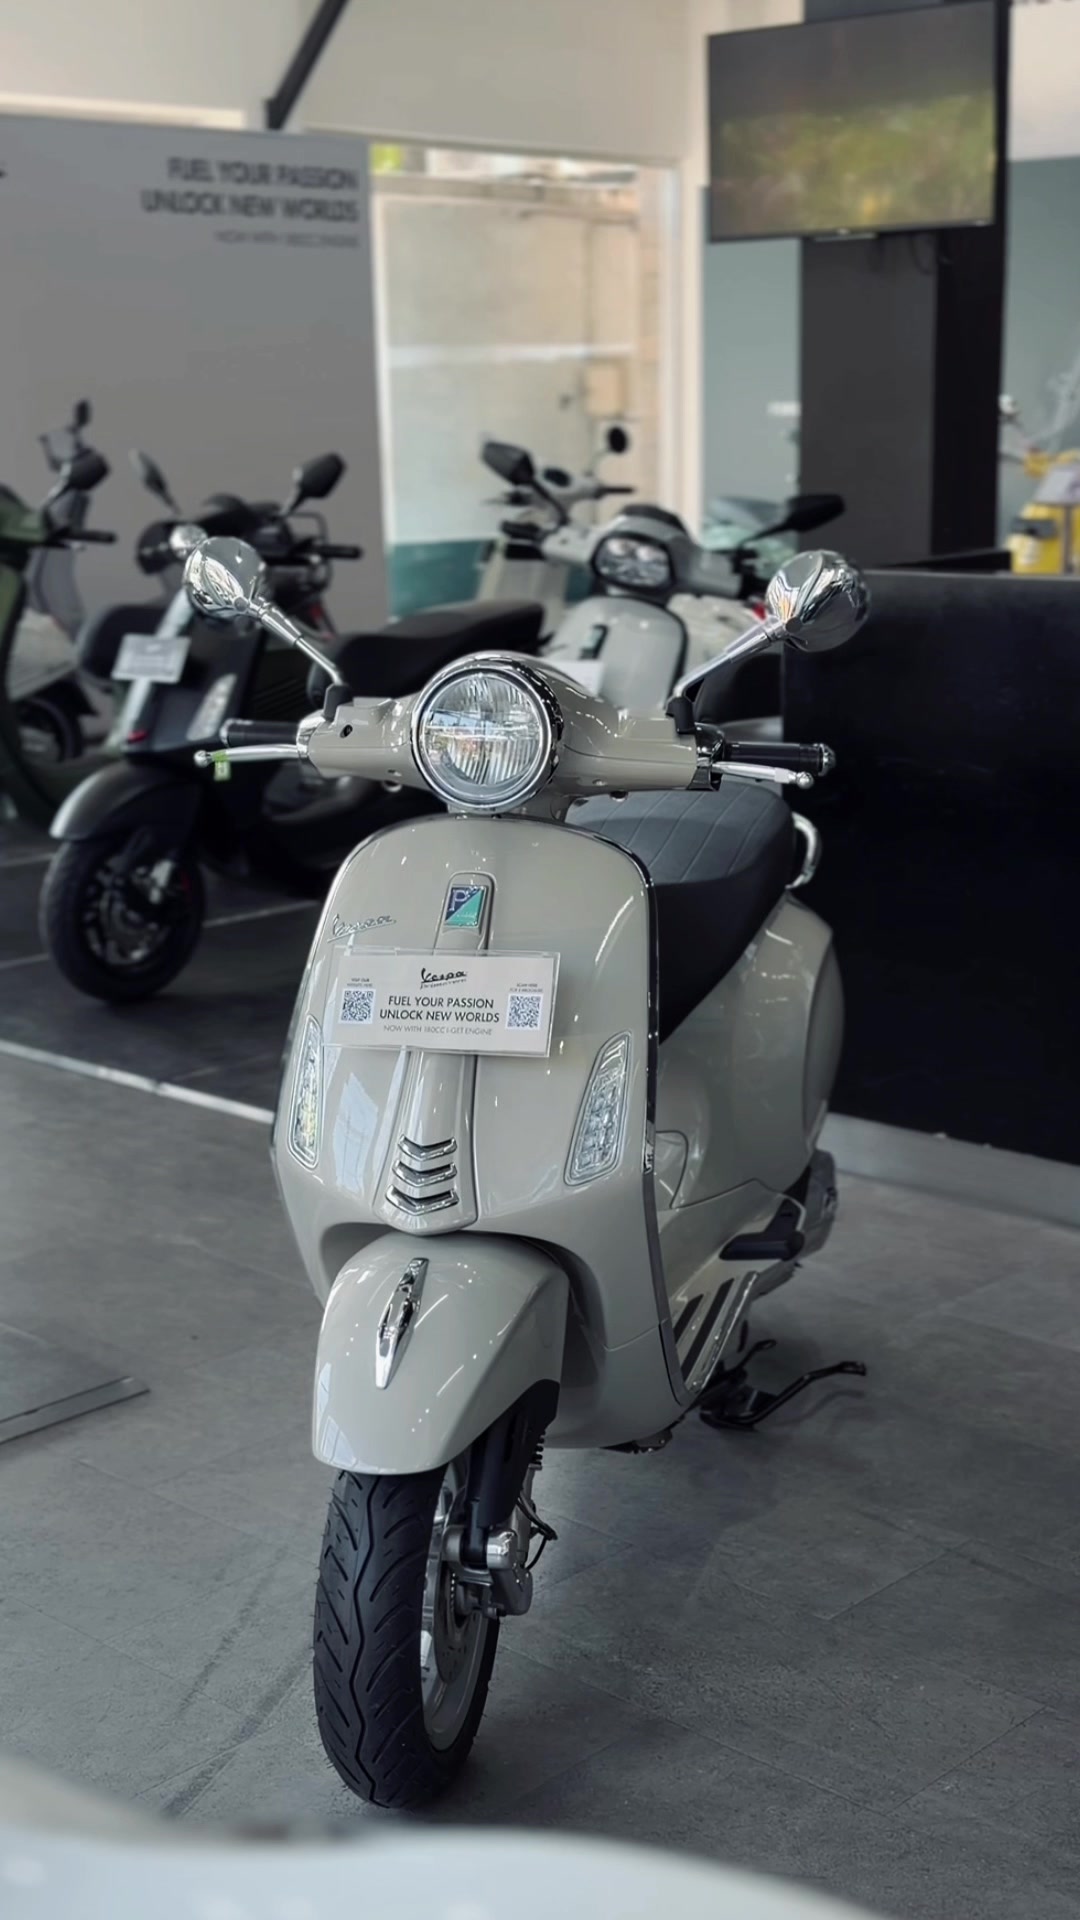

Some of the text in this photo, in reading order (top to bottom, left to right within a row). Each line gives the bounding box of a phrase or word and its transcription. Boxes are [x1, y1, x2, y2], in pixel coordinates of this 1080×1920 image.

[420, 967, 468, 984] Vespa
[388, 995, 494, 1009] FUEL YOUR PASSION
[379, 1009, 500, 1023] UNLOCK NEW WORLDS
[404, 1025, 422, 1033] WITH
[465, 1027, 493, 1036] ENGINE
